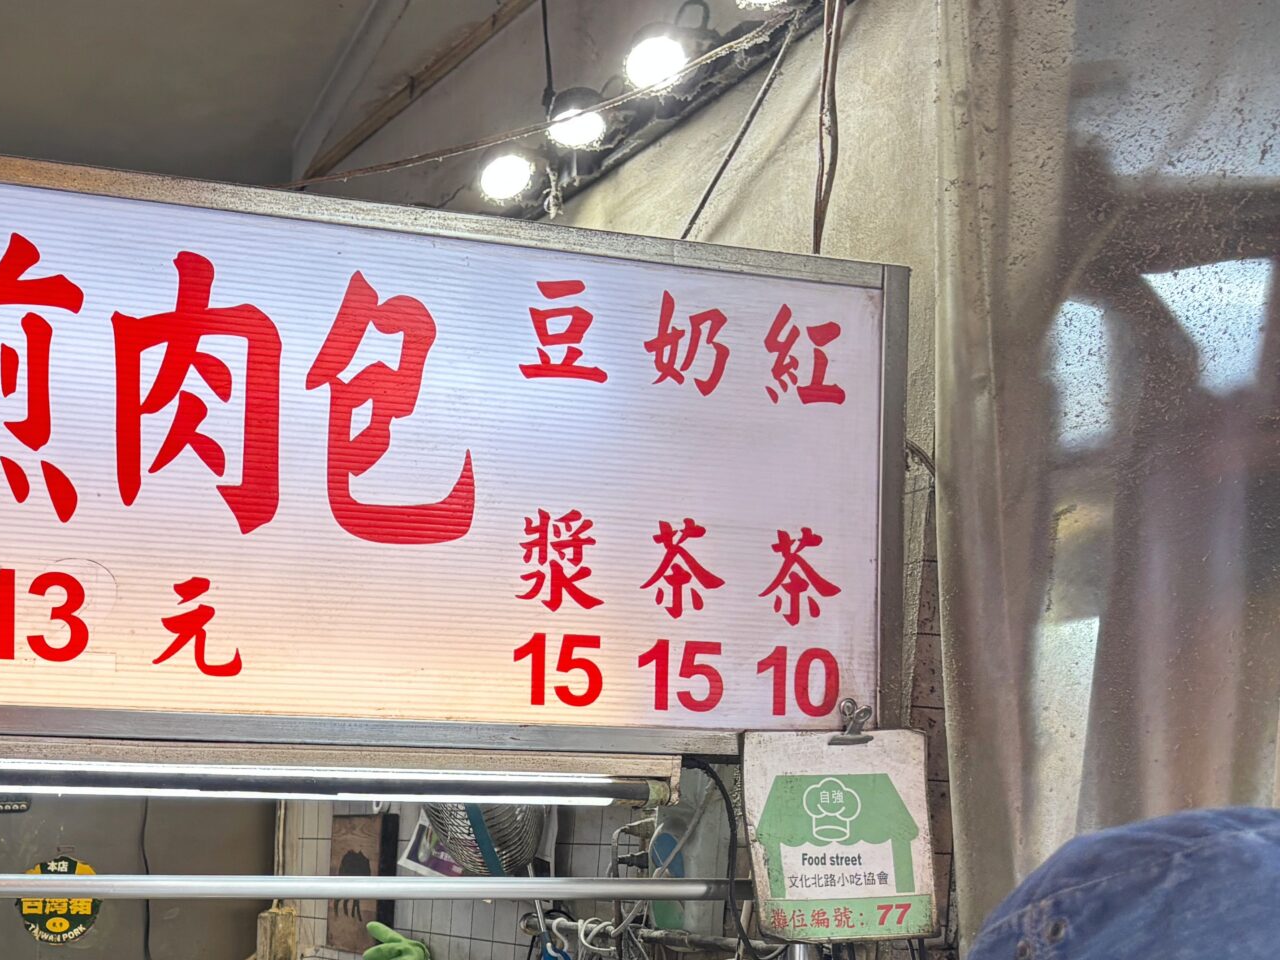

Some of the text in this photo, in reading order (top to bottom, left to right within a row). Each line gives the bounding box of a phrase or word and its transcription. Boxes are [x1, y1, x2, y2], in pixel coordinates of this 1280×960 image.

[516, 279, 608, 613] 豆漿
[640, 290, 731, 619] 奶茶
[759, 303, 846, 627] 紅茶
[152, 576, 243, 678] 元
[513, 631, 604, 708] 15
[638, 638, 725, 714] 15
[756, 645, 841, 719] 10
[820, 790, 844, 804] 自強
[47, 860, 69, 872] 本店
[788, 870, 889, 889] 文化北路小吃協會
[801, 852, 862, 866] Food street
[62, 924, 86, 942] PORK
[877, 903, 912, 926] 77
